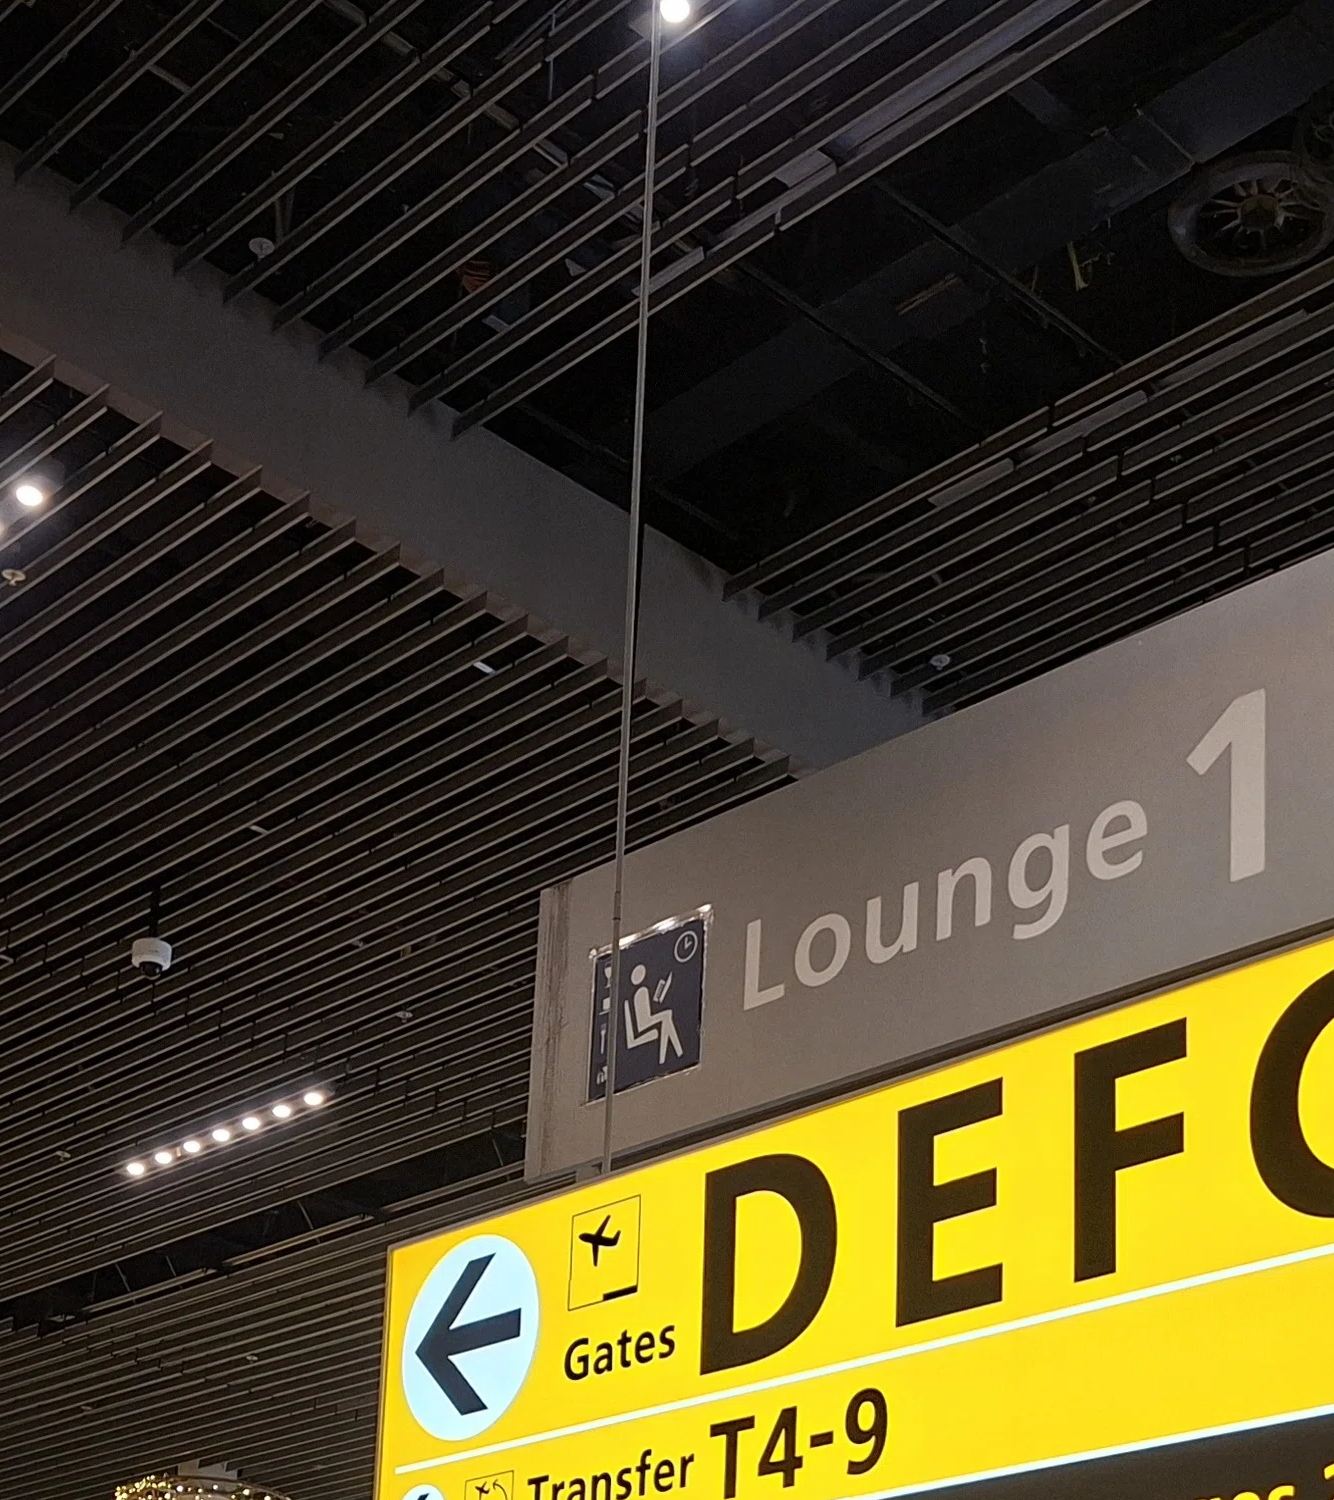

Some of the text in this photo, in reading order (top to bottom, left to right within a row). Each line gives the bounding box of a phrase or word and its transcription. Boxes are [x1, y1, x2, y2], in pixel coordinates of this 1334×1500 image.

[743, 688, 1266, 1010] Lounge 1
[564, 1322, 675, 1381] Gates
[709, 1387, 887, 1499] T4-9
